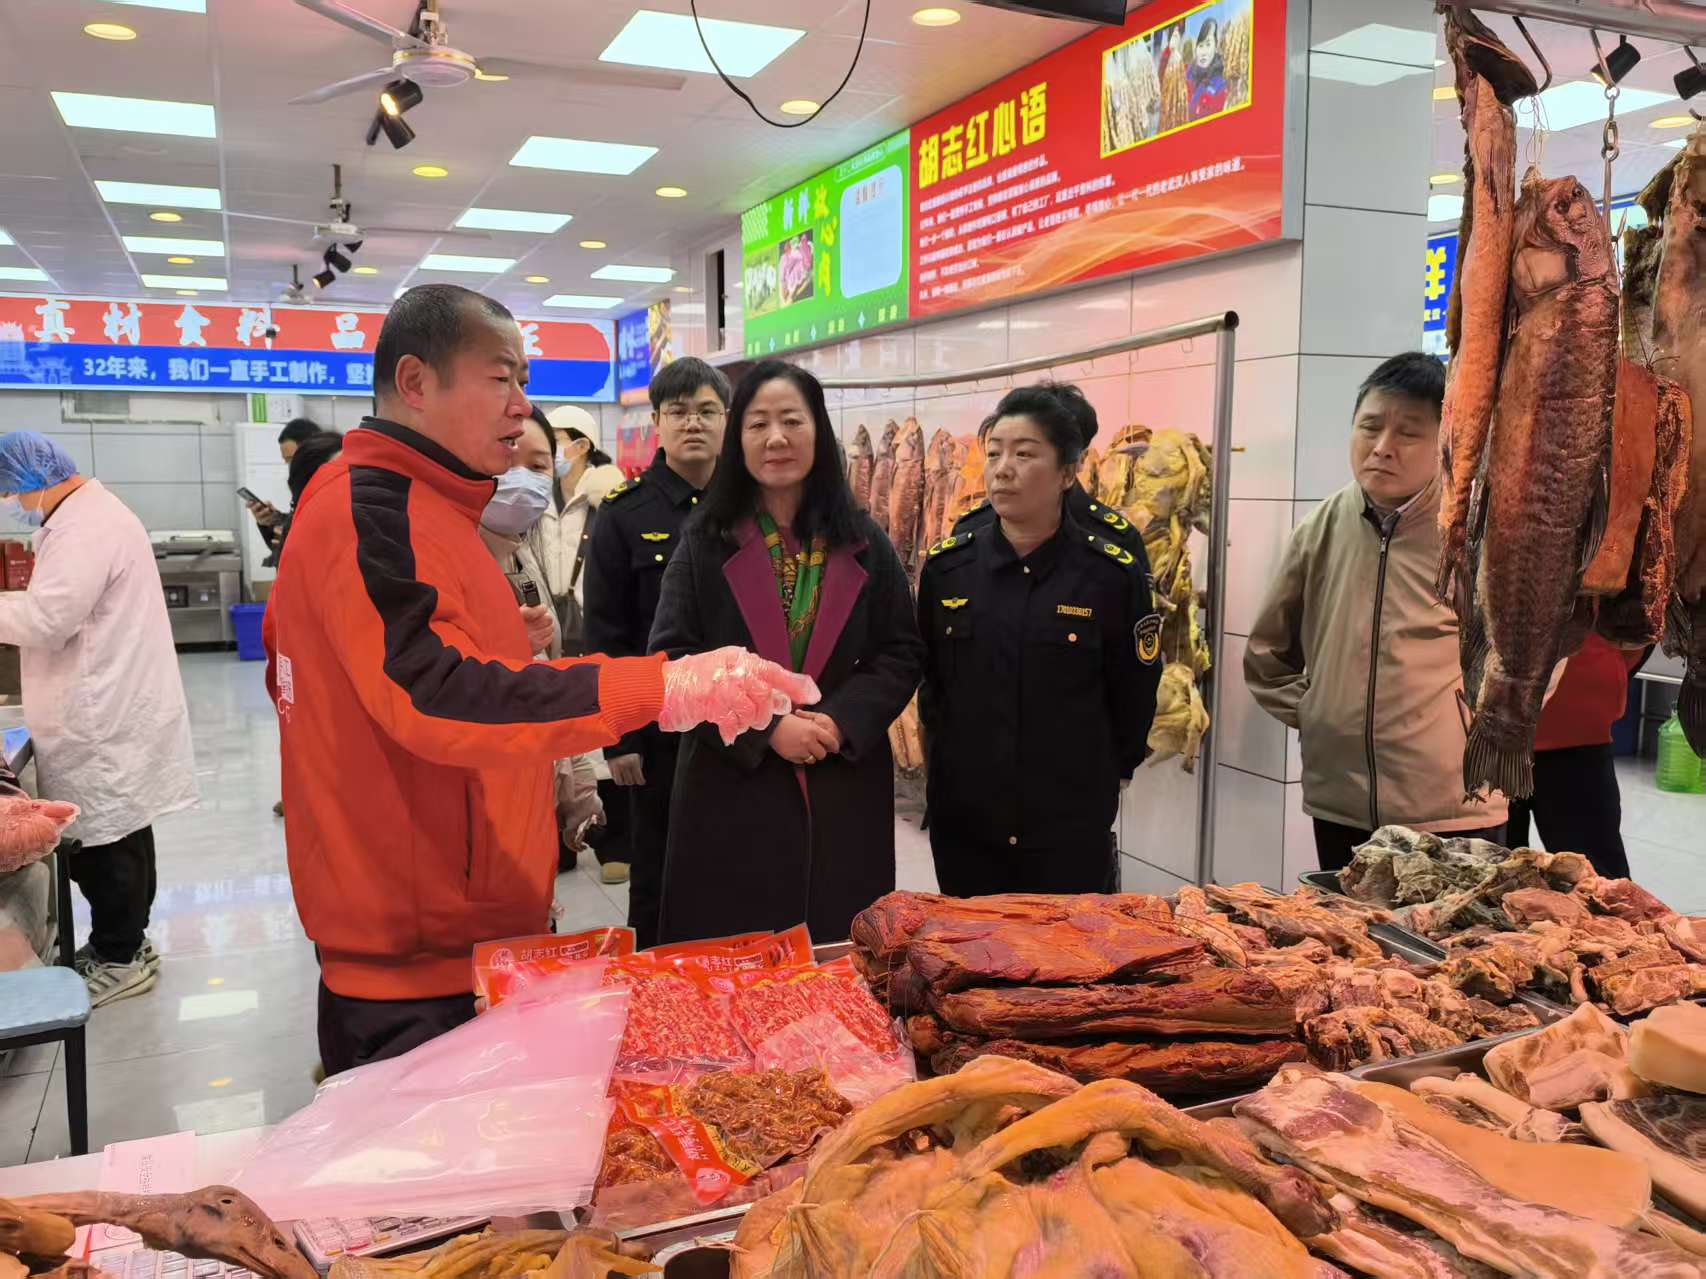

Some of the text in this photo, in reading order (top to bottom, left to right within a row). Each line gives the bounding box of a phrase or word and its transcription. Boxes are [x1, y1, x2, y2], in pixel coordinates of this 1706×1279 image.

[918, 82, 1047, 190] 胡志红心语
